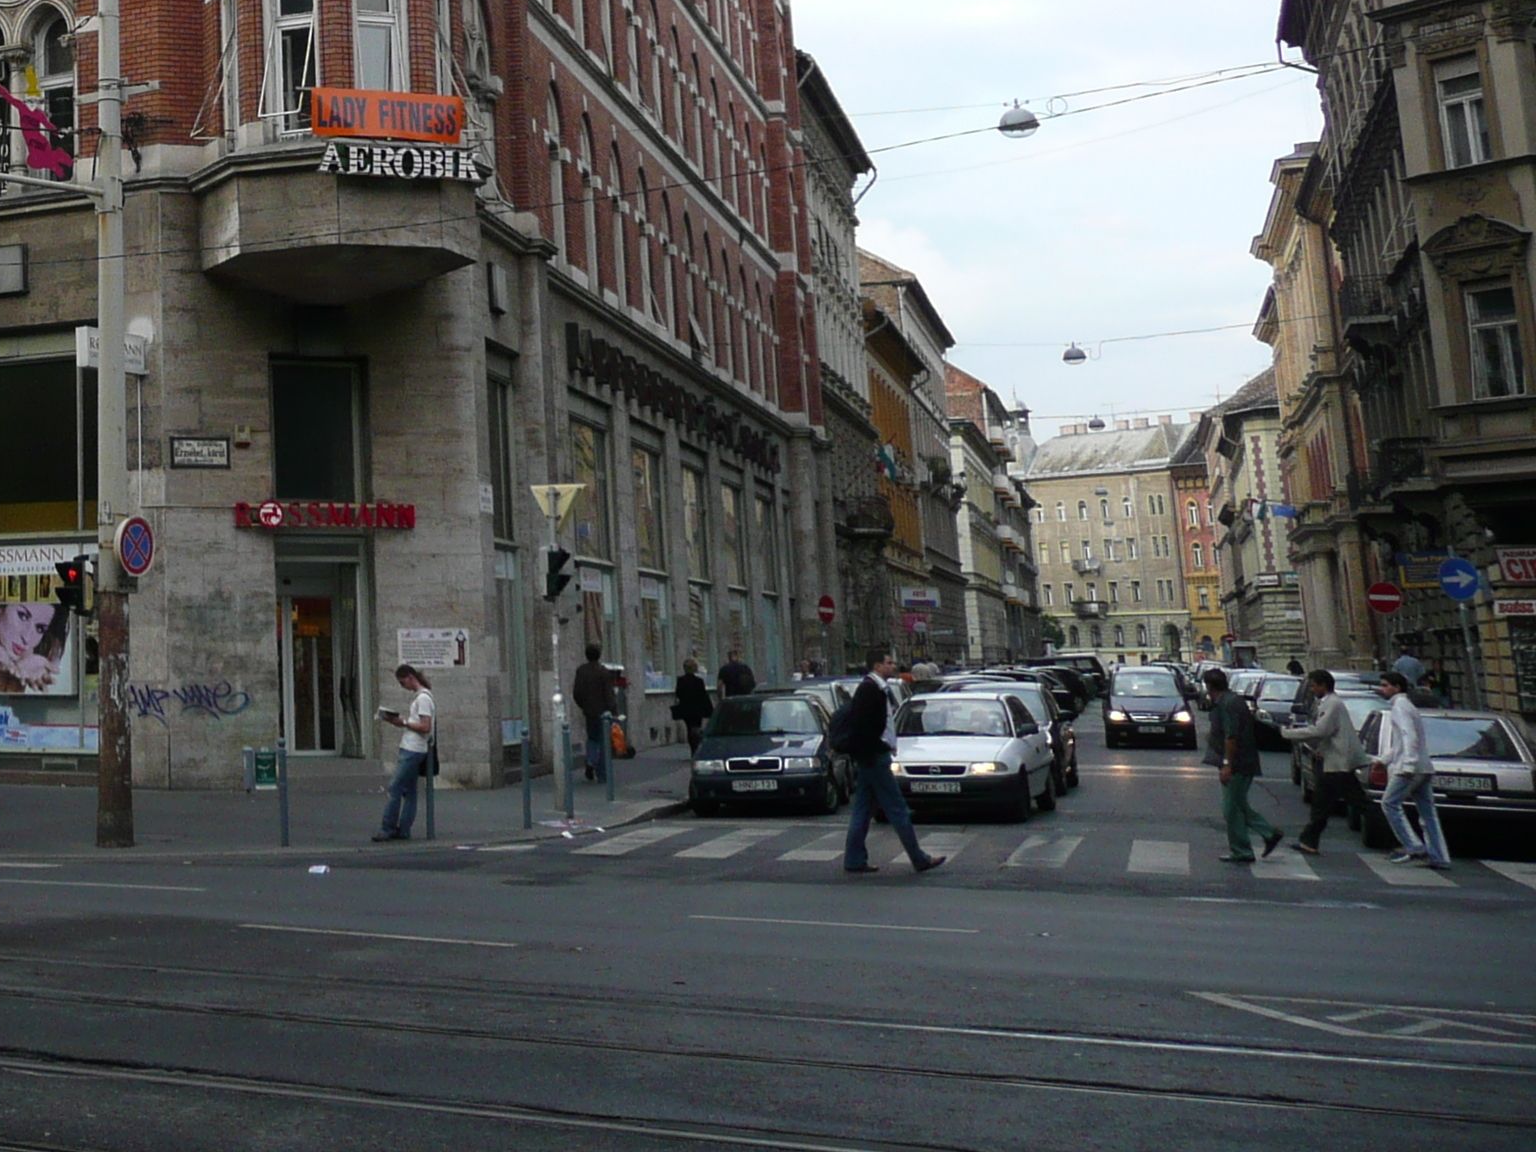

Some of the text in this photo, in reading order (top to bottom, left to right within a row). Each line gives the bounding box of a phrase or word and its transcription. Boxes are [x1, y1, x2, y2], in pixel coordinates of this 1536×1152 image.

[316, 95, 457, 137] LADY FITNESS
[319, 142, 481, 180] AEROBIK
[235, 500, 416, 528] ROSSMANN
